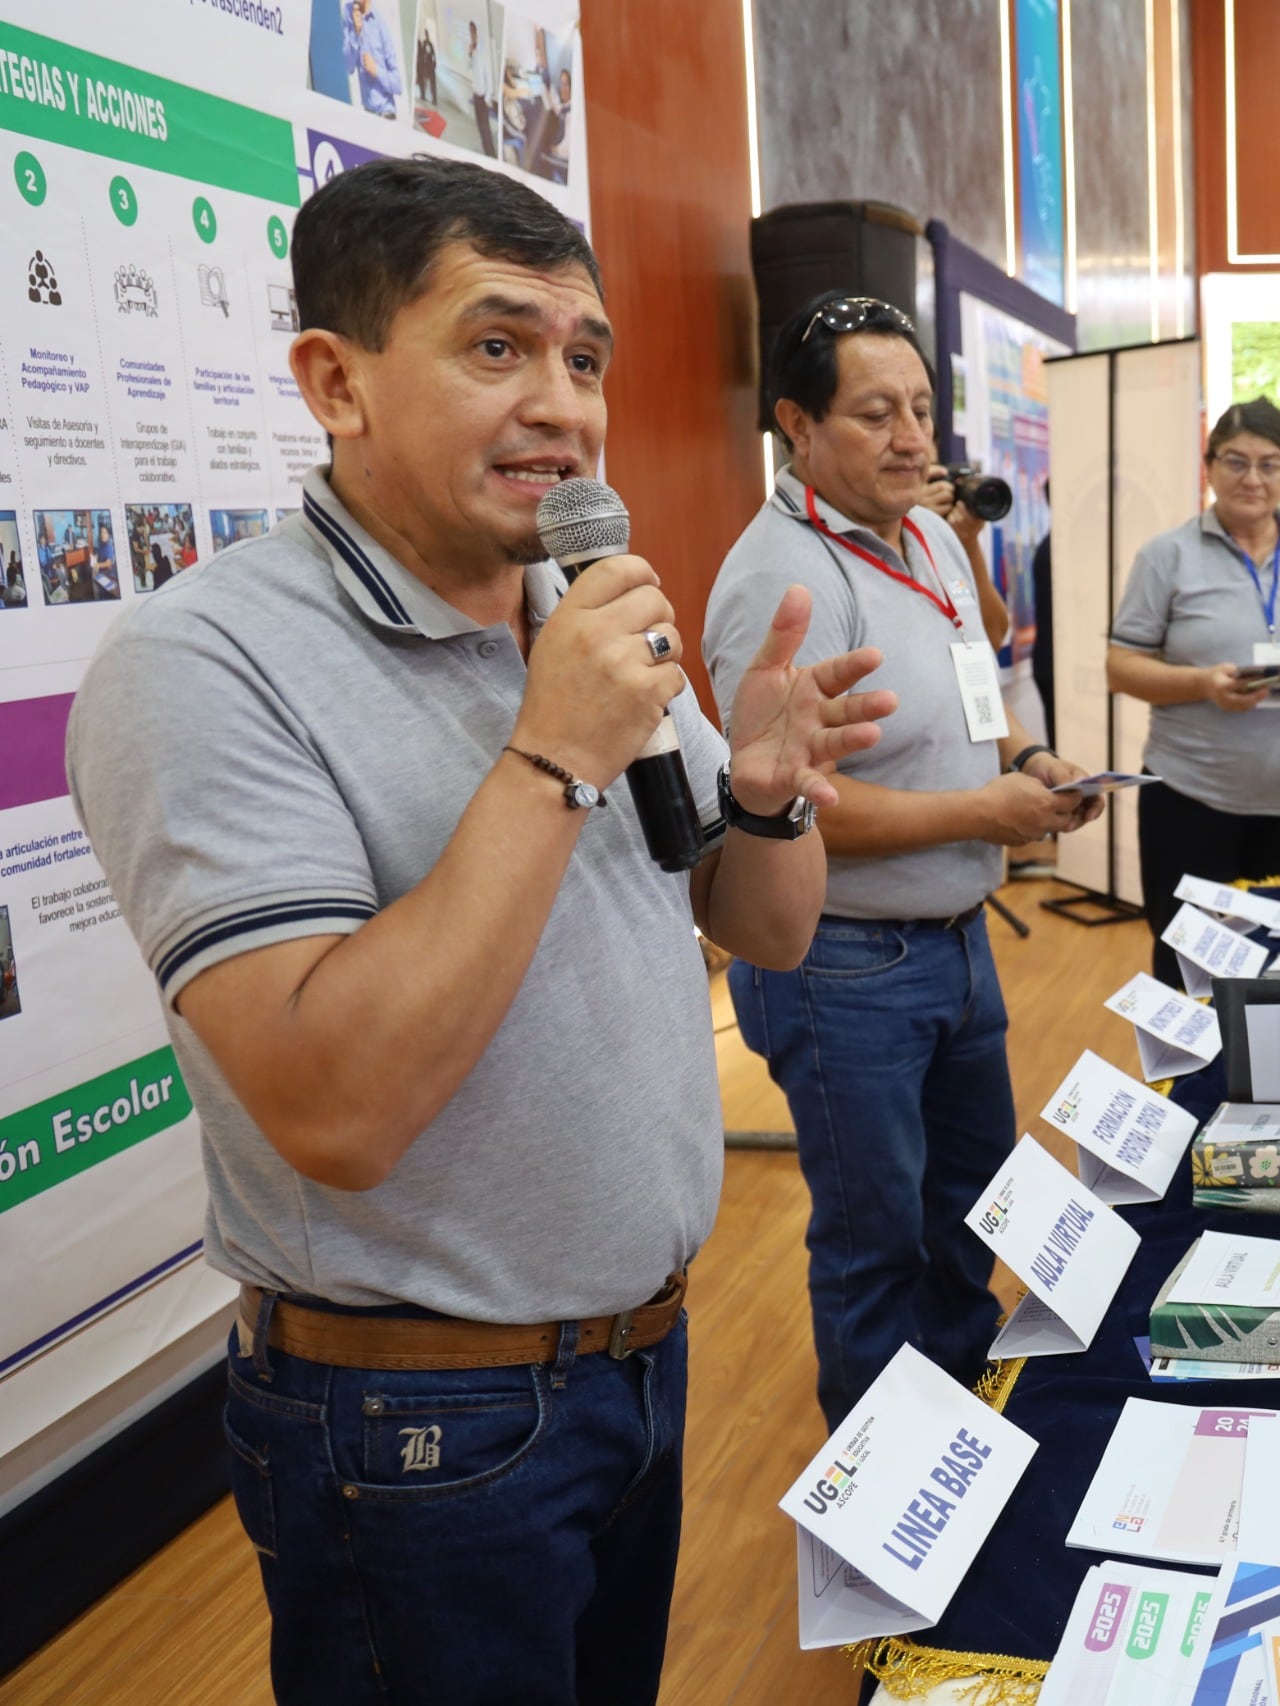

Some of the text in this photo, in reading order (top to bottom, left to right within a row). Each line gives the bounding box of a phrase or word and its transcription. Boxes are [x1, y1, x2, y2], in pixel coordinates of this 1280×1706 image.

[210, 0, 283, 35] ascienden2
[0, 48, 168, 142] TEGIAS Y ACCIONES
[24, 169, 38, 192] 2
[117, 188, 130, 210] 3
[199, 209, 210, 228] 4
[273, 229, 283, 247] 5
[30, 348, 68, 362] Monitoreo
[119, 358, 165, 372] Comunidades
[21, 362, 87, 378] Acompañamiento
[116, 372, 172, 386] Profesionales de
[21, 377, 67, 393] Pedagógico
[74, 381, 90, 393] VAP
[127, 387, 166, 401] Aprendizaje
[26, 416, 51, 429] Visitas
[51, 417, 61, 430] de
[136, 421, 168, 434] Grupos de
[24, 436, 67, 450] seguimiento
[74, 437, 105, 449] docentes
[6, 834, 59, 859] articulación
[60, 829, 83, 844] entre
[0, 854, 52, 877] comunidad
[53, 844, 92, 863] fortalece
[31, 896, 41, 910] El
[42, 887, 72, 907] trabajo
[38, 904, 75, 925] favorece
[76, 902, 84, 912] la
[69, 915, 98, 933] mejora
[0, 1074, 173, 1182] ón Escolar
[1092, 1088, 1137, 1145] FORMACIÓN
[1030, 1199, 1095, 1292] AULA VIRTUAL
[1215, 1416, 1235, 1432] 20
[398, 1424, 442, 1473] B
[836, 1481, 859, 1509] ASCOPE
[882, 1427, 993, 1572] LINEA BASE
[1092, 1592, 1122, 1643] 2025
[1133, 1600, 1161, 1651] 2025
